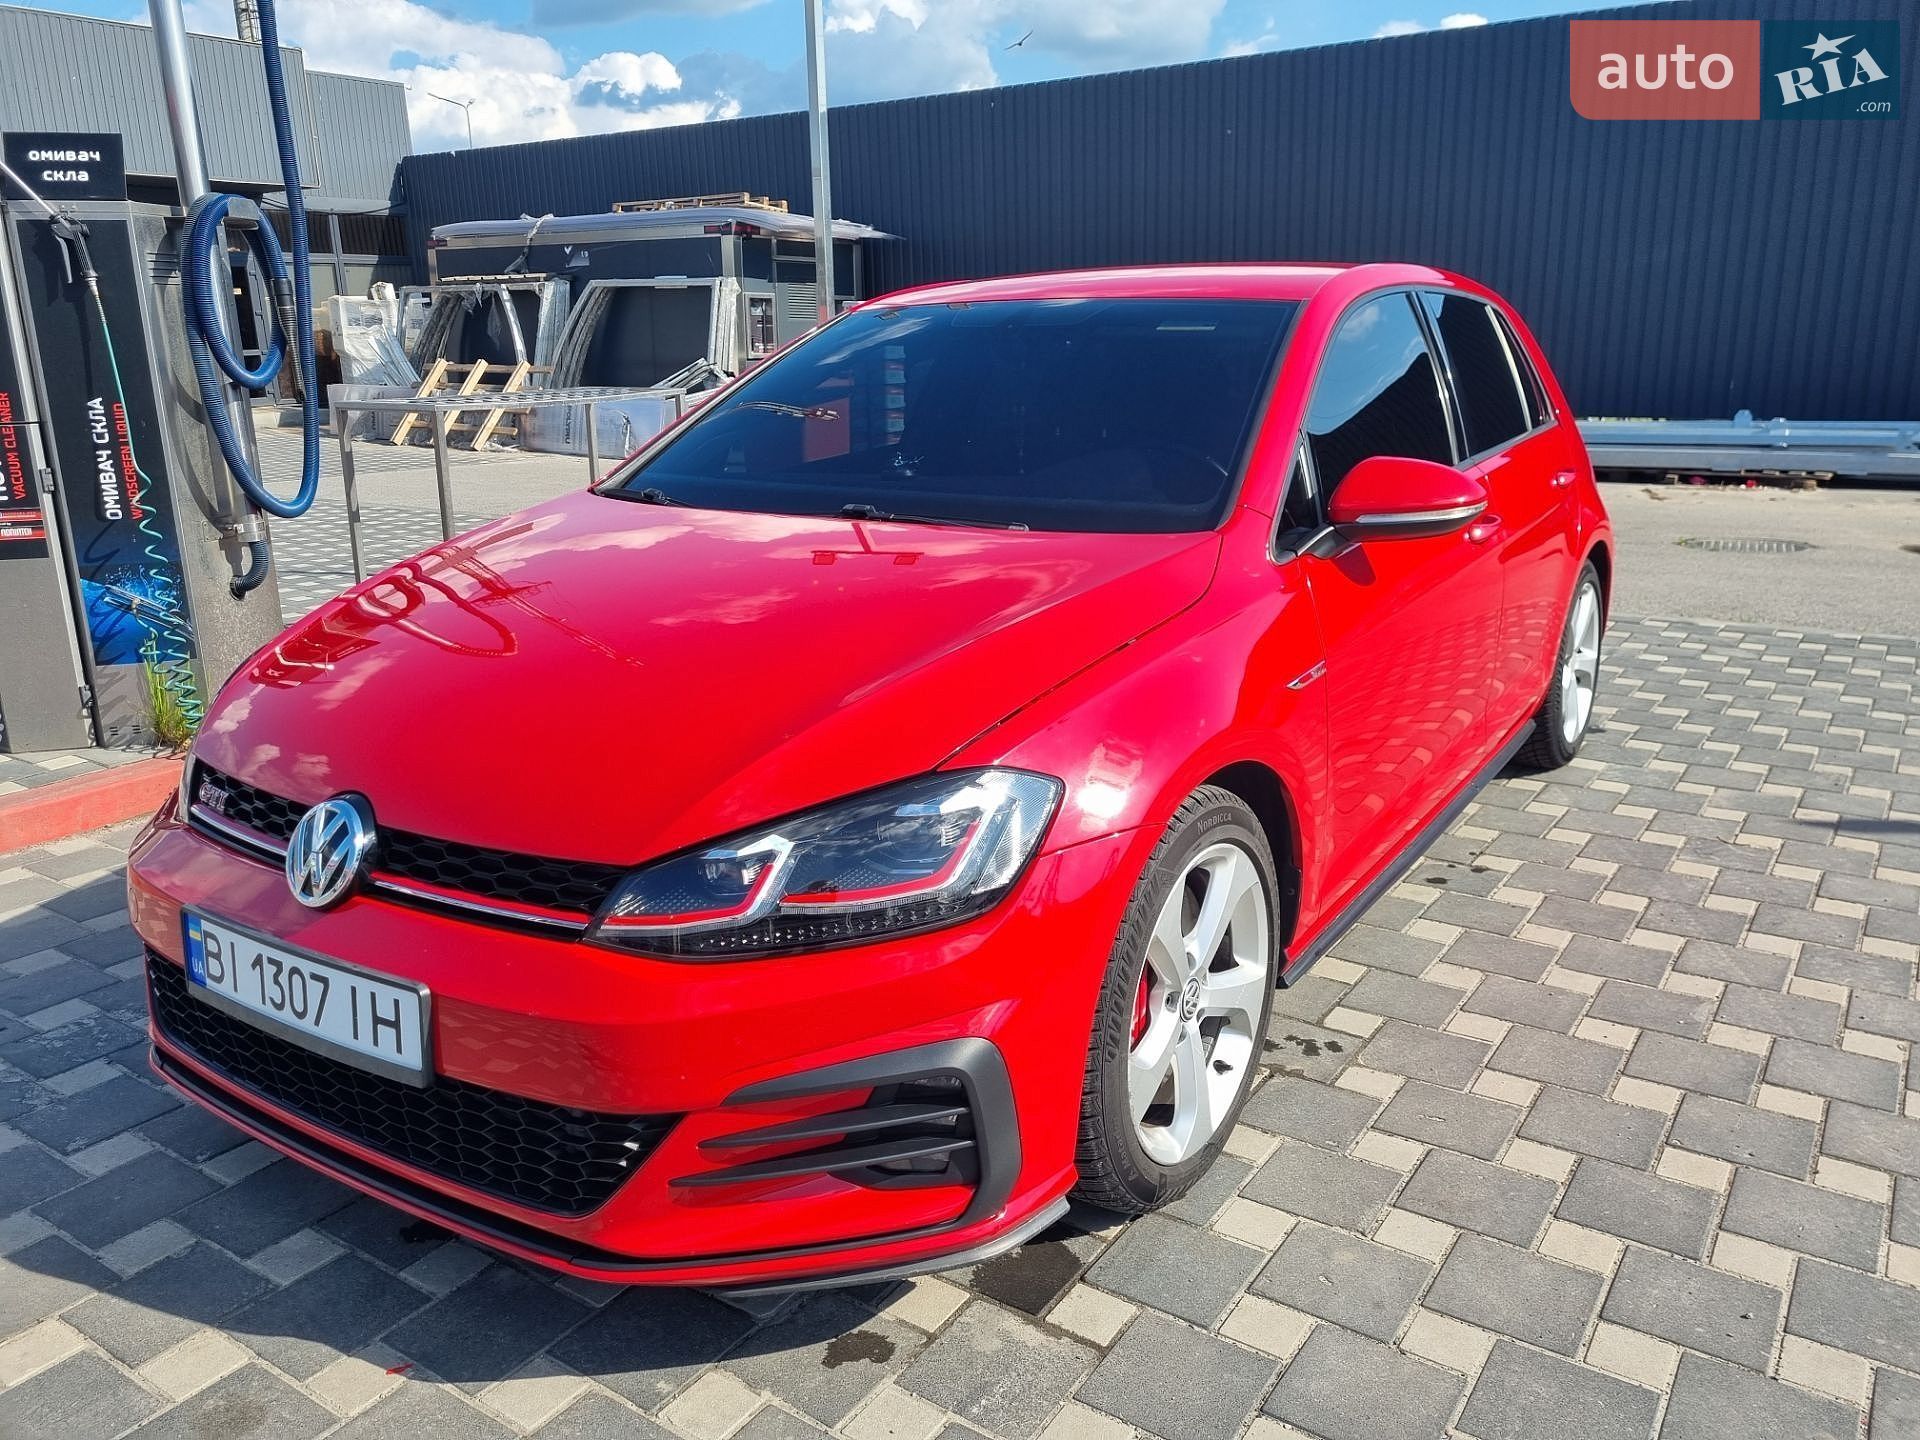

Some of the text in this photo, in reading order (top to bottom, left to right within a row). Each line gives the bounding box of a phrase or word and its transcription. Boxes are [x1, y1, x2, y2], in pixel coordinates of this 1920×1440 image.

[43, 170, 89, 181] скла
[6, 452, 27, 500] VACUUM
[87, 397, 122, 520] ОМИВАЧ СКЛА
[199, 781, 229, 811] GTI
[192, 957, 204, 977] UA
[202, 929, 403, 1055] BI 1307 IH
